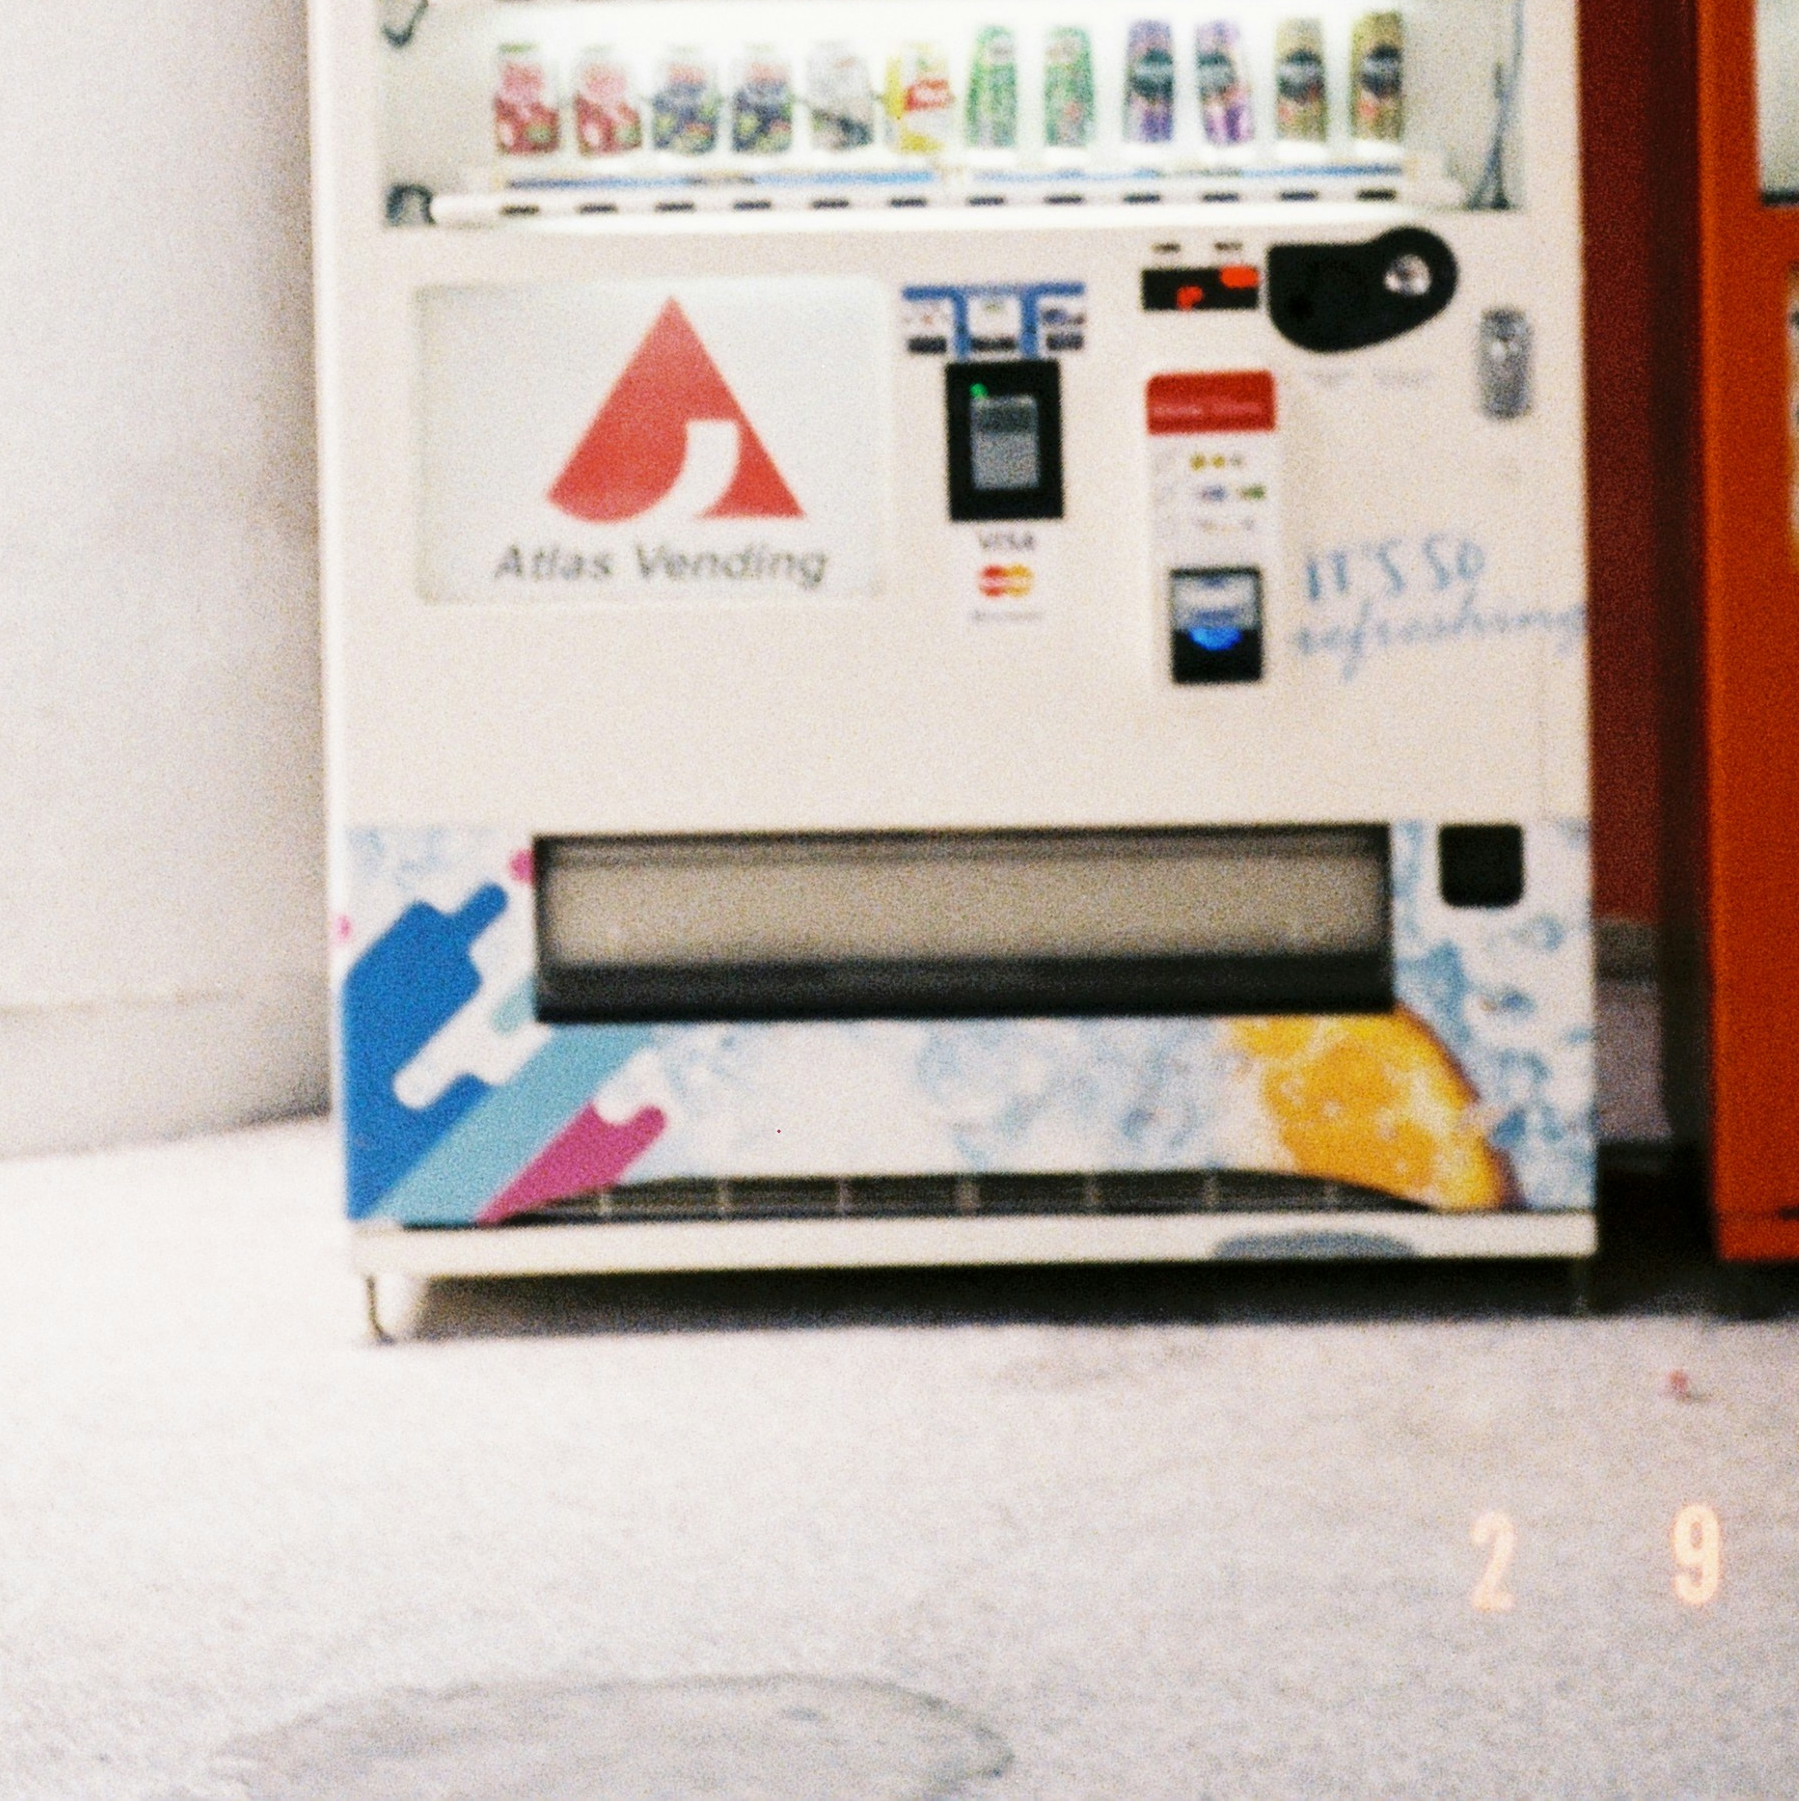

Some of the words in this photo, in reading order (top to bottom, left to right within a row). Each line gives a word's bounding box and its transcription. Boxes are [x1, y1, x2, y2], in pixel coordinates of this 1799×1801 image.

[975, 529, 1038, 552] VISA
[495, 543, 614, 581] Atlas
[635, 542, 830, 590] Vending
